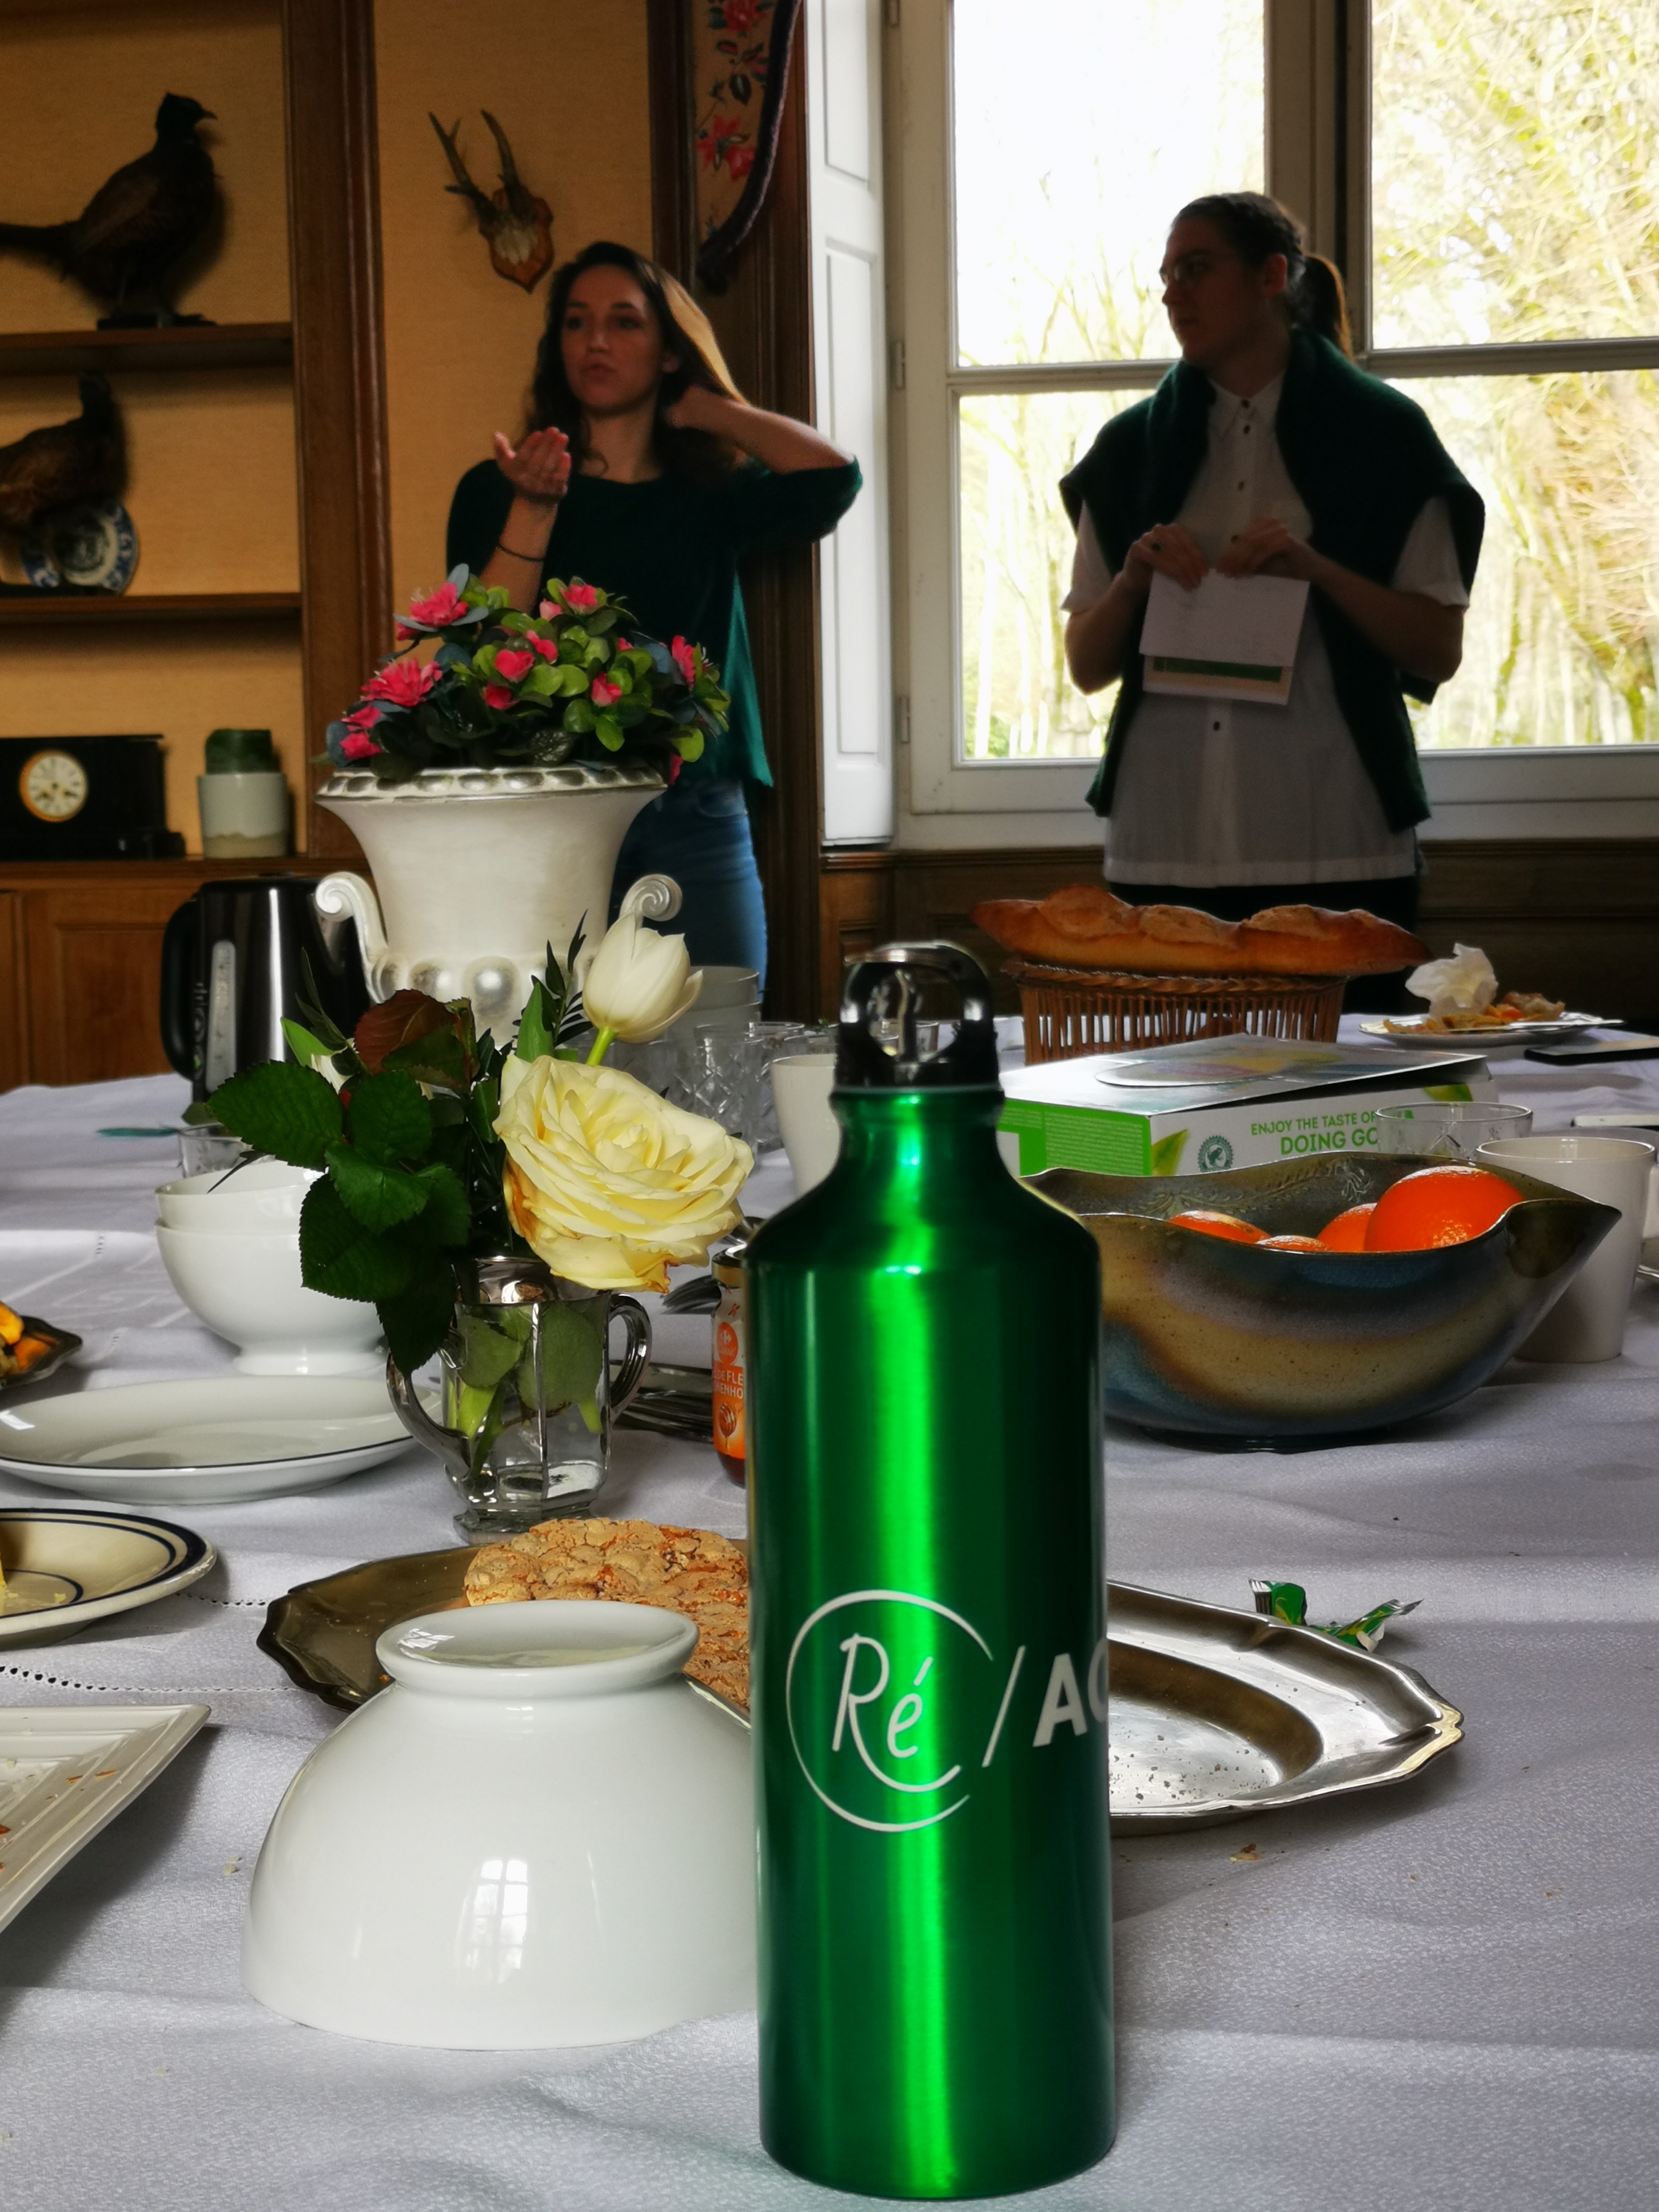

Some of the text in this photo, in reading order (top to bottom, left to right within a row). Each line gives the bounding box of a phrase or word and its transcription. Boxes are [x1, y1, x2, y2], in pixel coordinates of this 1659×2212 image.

[1251, 1121, 1292, 1136] ENJOY
[1296, 1118, 1318, 1130] THE
[1322, 1113, 1357, 1127] TASTE
[1281, 1131, 1346, 1155] DOING
